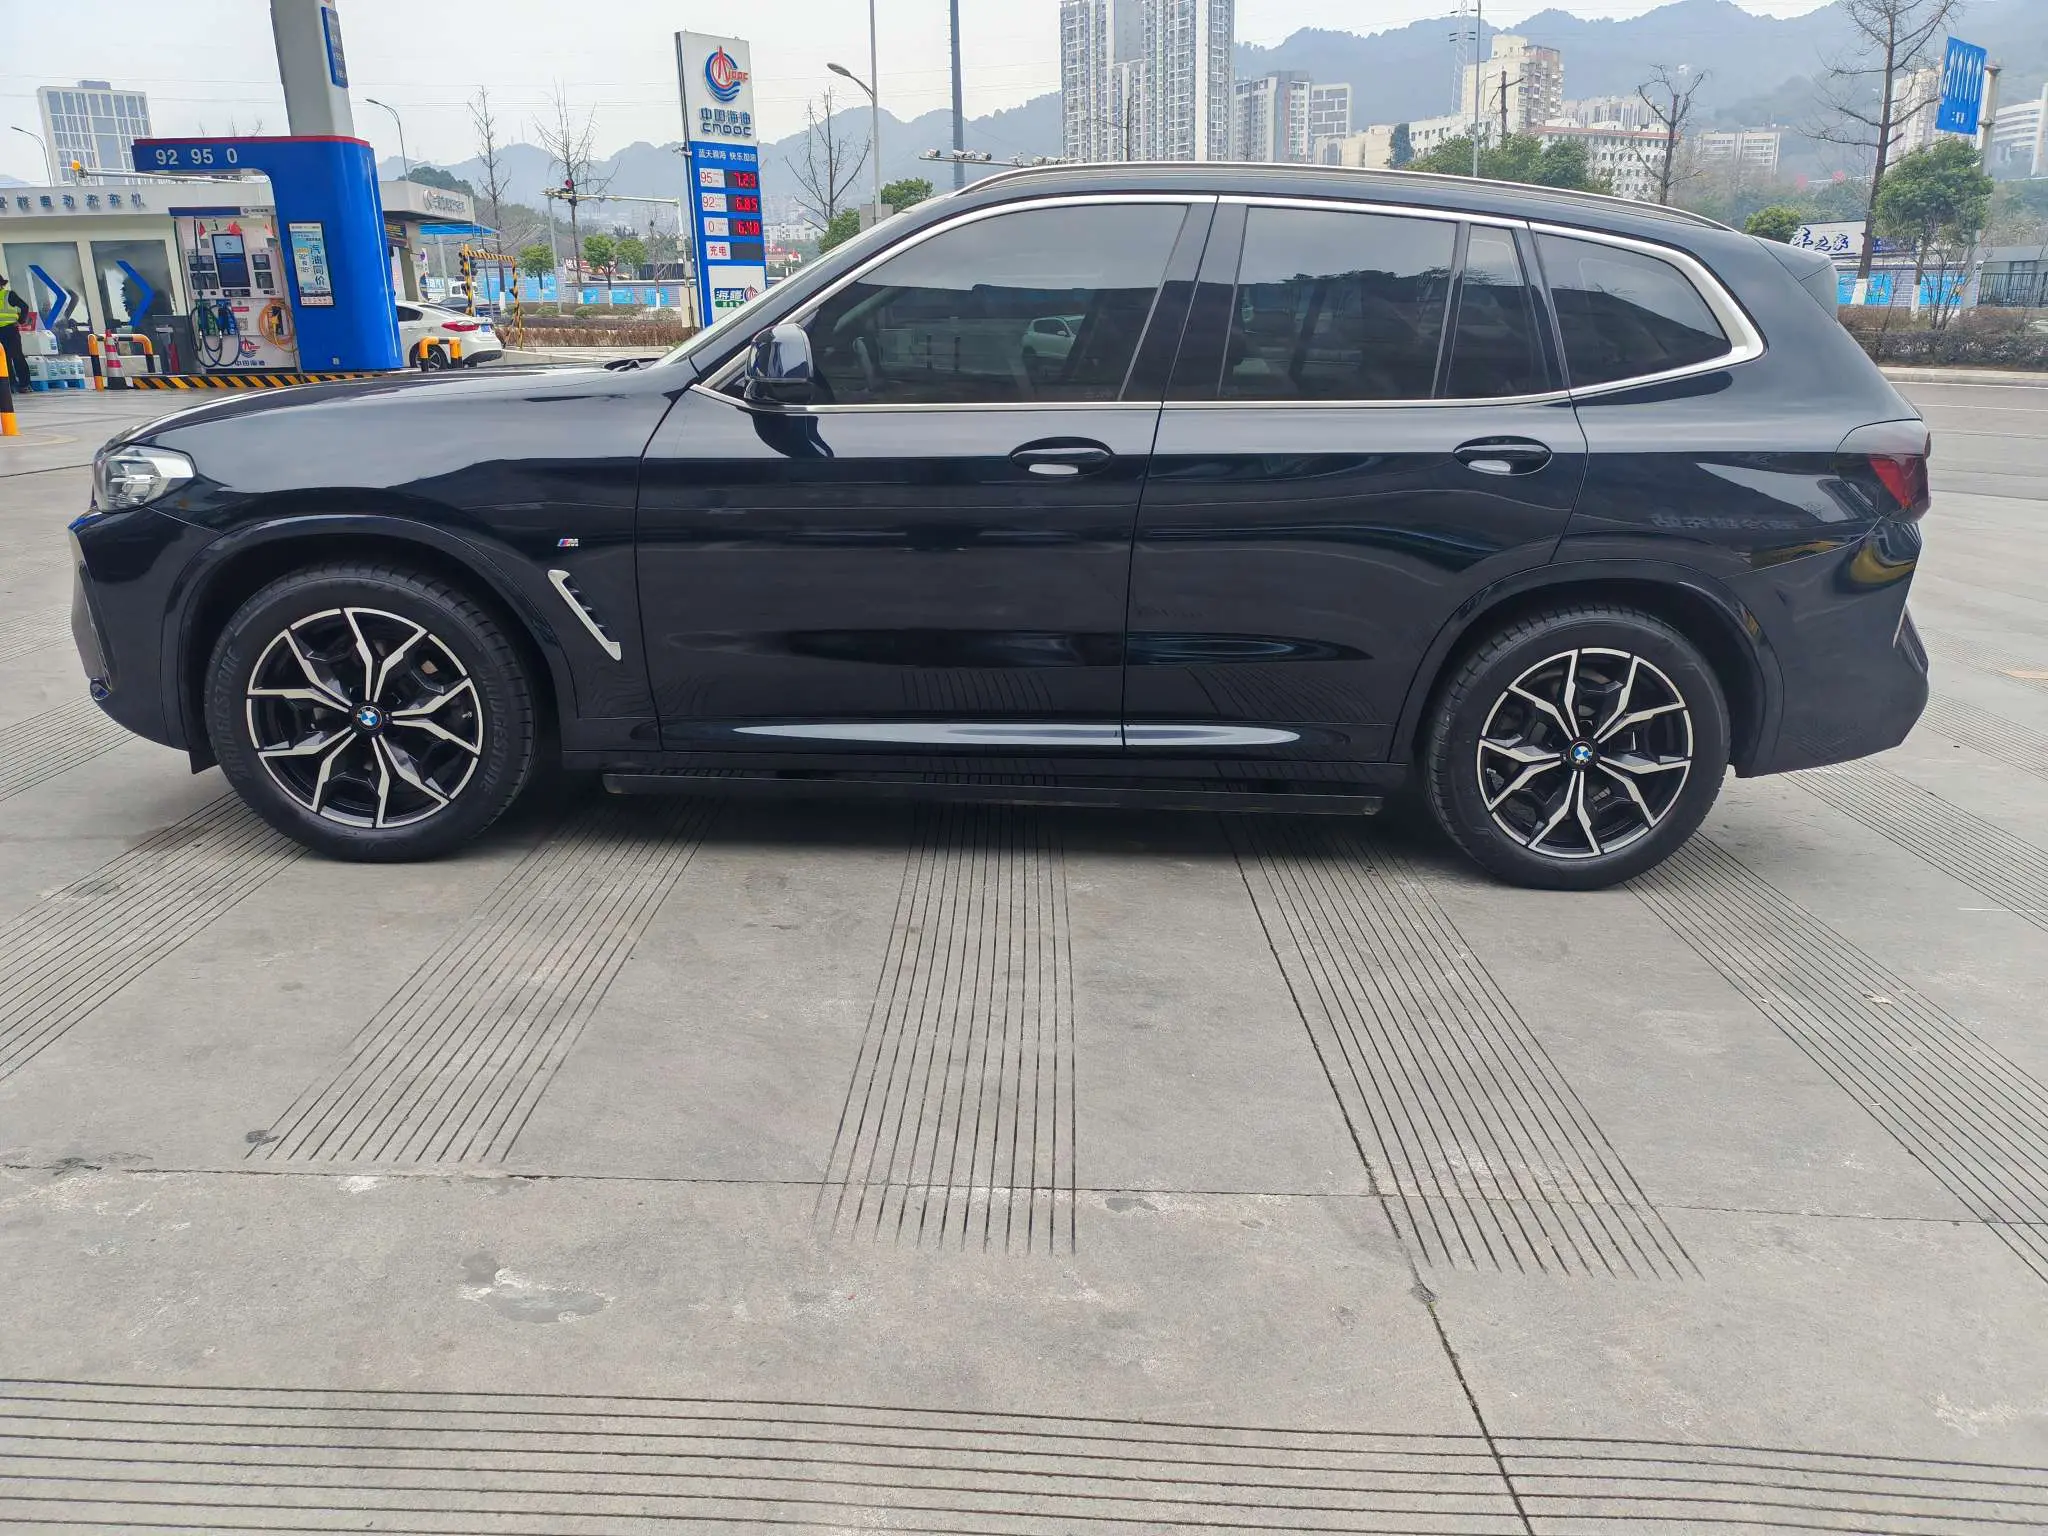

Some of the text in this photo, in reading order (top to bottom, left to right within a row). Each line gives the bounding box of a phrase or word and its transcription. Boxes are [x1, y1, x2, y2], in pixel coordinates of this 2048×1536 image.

[701, 107, 751, 124] 中国海油
[156, 148, 238, 165] 92 95 0
[701, 172, 713, 183] 95
[703, 197, 715, 208] 92
[709, 221, 715, 233] 0
[709, 245, 727, 257] 充电
